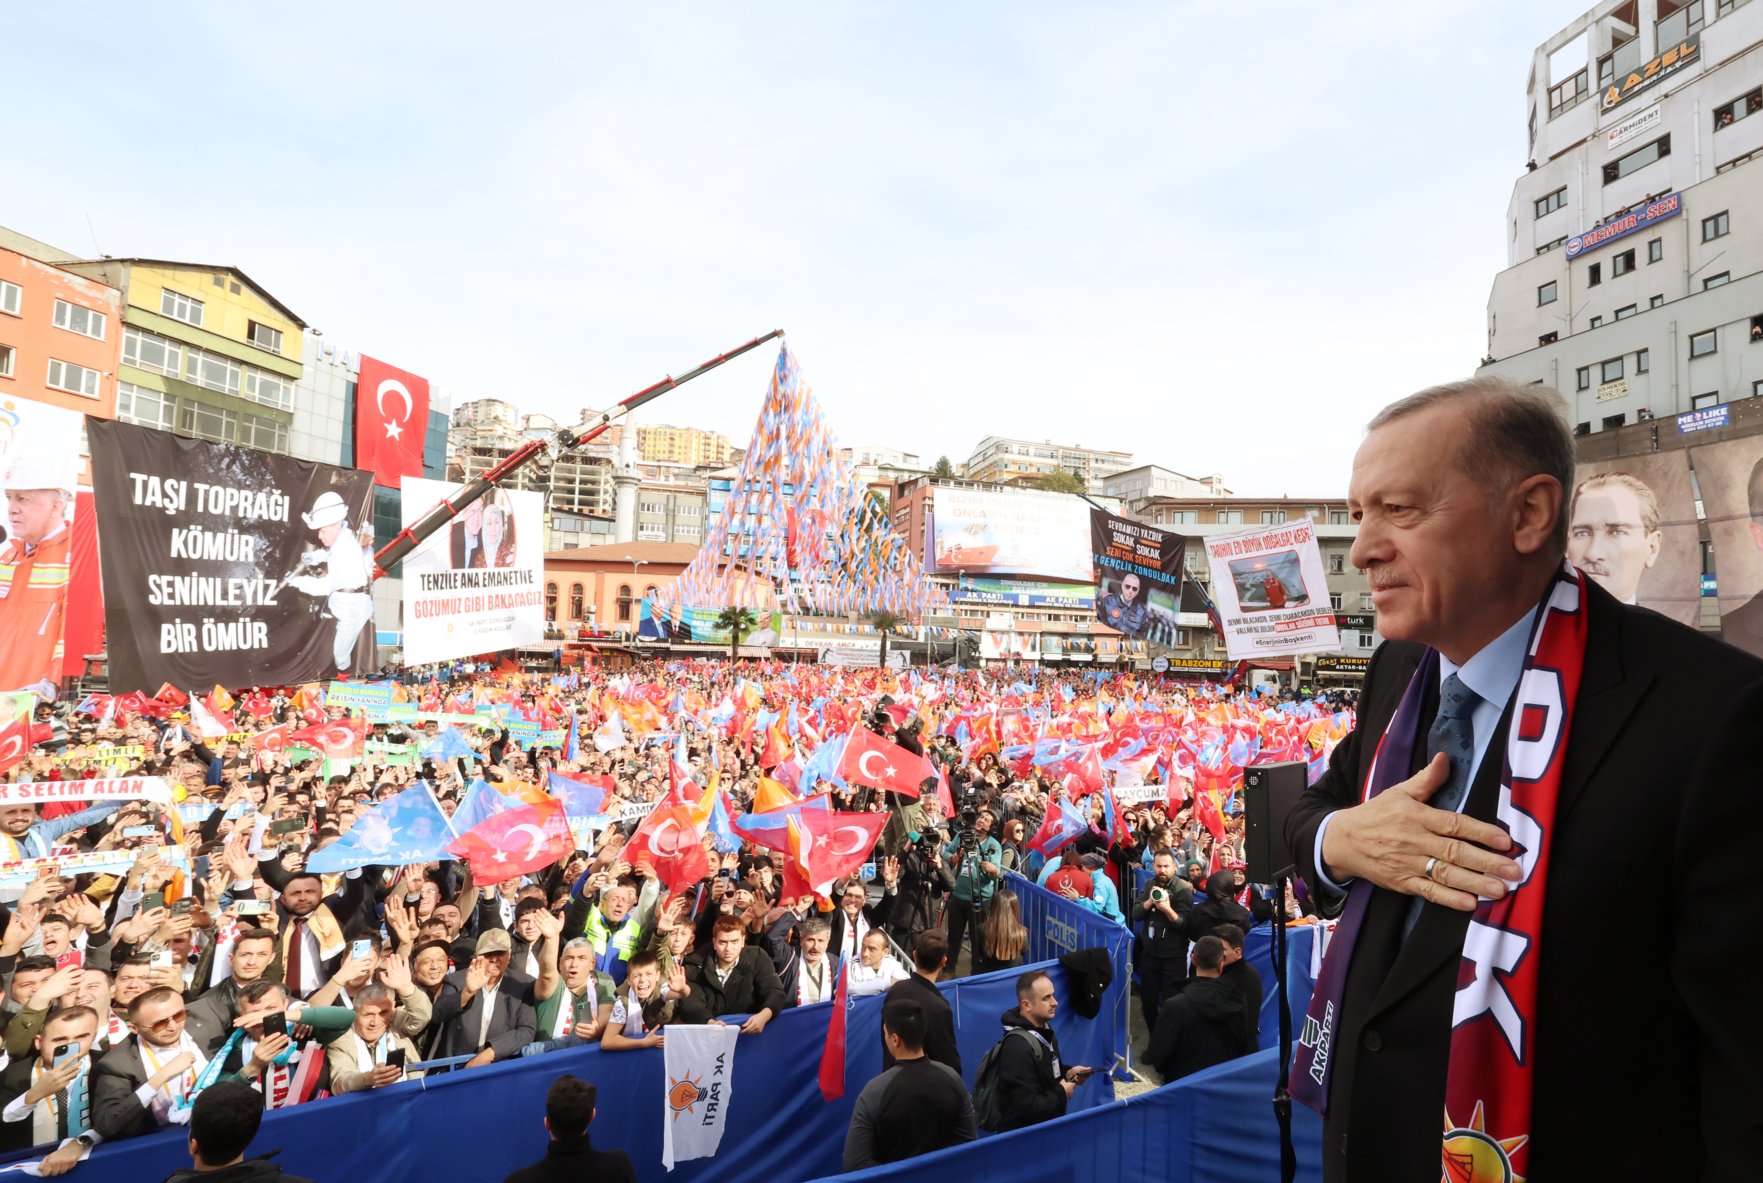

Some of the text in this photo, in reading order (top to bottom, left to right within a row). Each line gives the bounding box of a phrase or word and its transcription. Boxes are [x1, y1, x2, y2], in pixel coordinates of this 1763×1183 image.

[1622, 42, 1697, 92] AZEL
[1583, 214, 1637, 248] MEMUR
[1647, 195, 1678, 220] SEN
[1678, 407, 1728, 425] ME LIKE
[129, 472, 289, 522] TAŞI TOPRAĞI
[170, 524, 255, 562] KÖMÜR
[1108, 520, 1163, 543] SEVDAMIZI YAZDIK
[1106, 546, 1162, 570] SENİ ÇOK SEVİYOR
[1112, 532, 1161, 560] SOKAK SOKAK
[420, 569, 458, 592] TENZİLE
[460, 572, 480, 589] ANA
[1099, 556, 1132, 572] GENÇLİK
[1134, 562, 1176, 585] ZONGULDAK
[148, 571, 278, 606] SENİNLEYİZ
[414, 596, 462, 619] GÖZÜMÜZ
[464, 594, 485, 613] GİBİ
[693, 611, 719, 621] GER
[160, 617, 268, 654] BİR ÖMÜR
[1255, 634, 1314, 648] #EnerjininBaşkenti
[1170, 659, 1211, 668] TRABZON
[93, 779, 145, 796] ALAN
